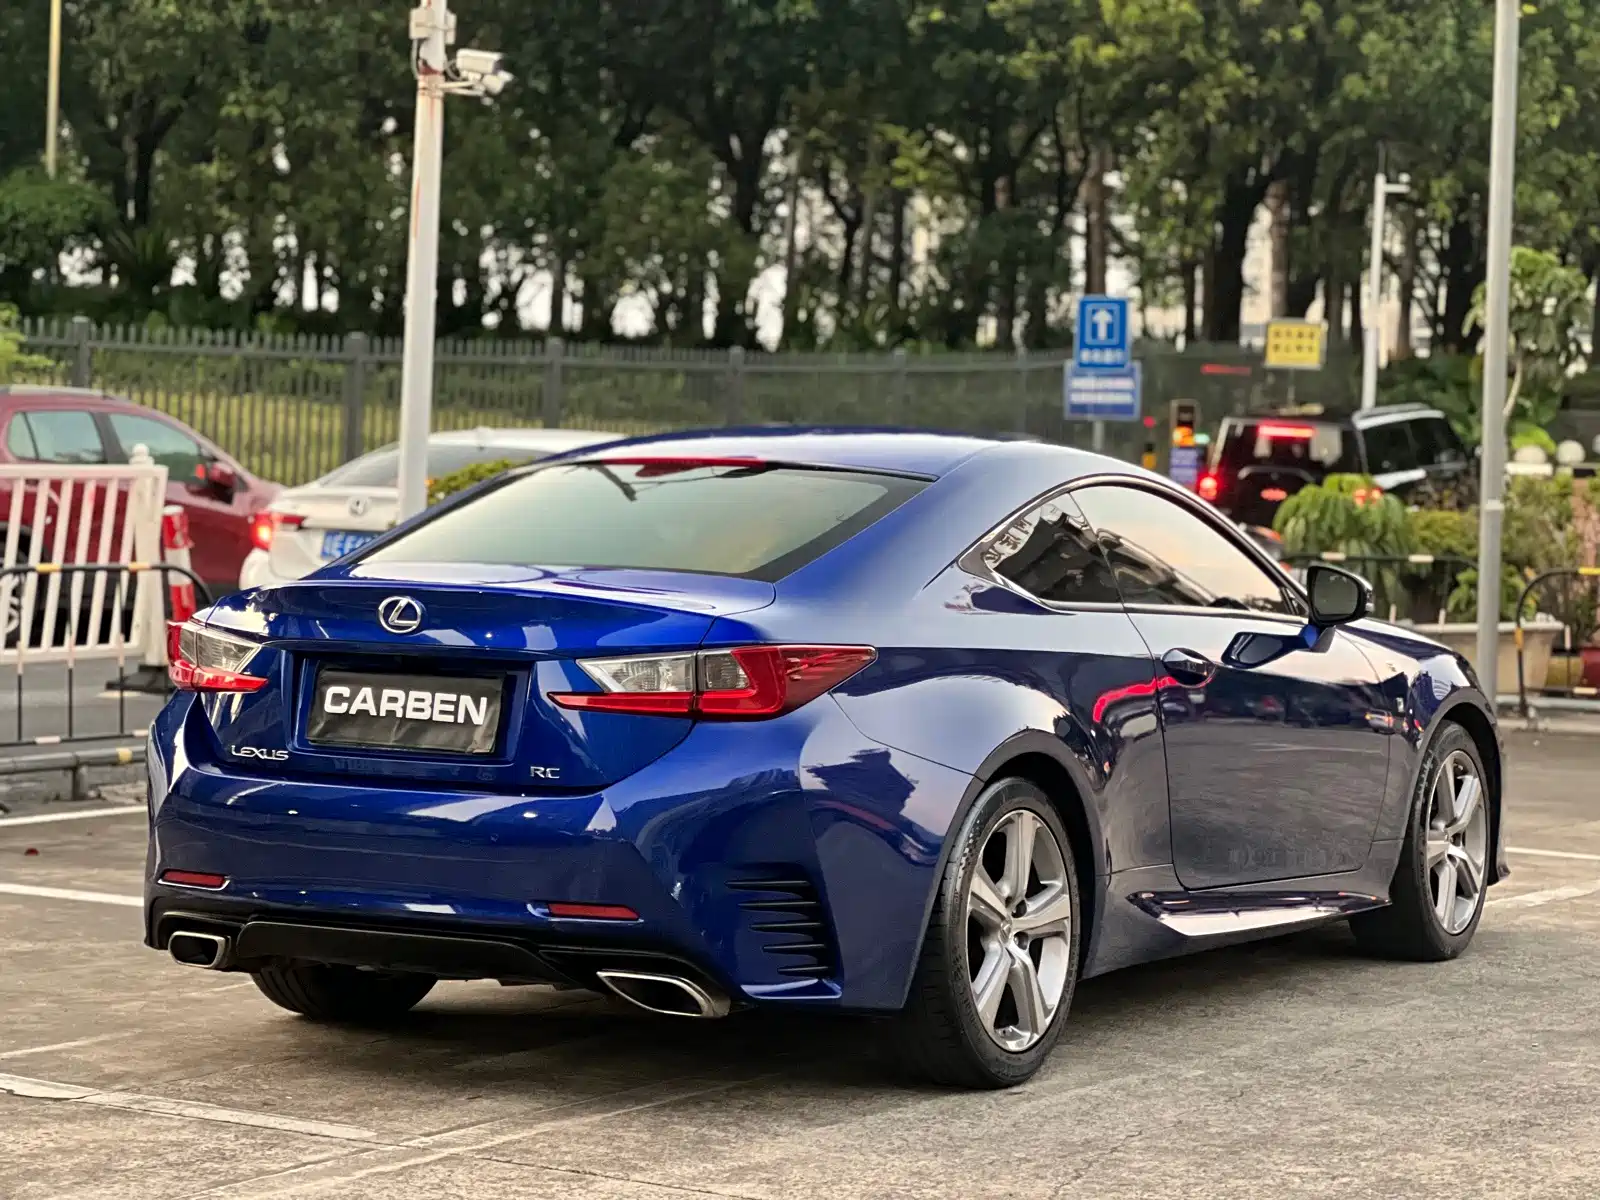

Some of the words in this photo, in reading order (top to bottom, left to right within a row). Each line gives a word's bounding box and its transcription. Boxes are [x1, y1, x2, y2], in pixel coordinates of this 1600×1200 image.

[324, 686, 487, 725] CARBEN
[231, 745, 289, 760] LEXUS
[530, 766, 560, 779] RC
